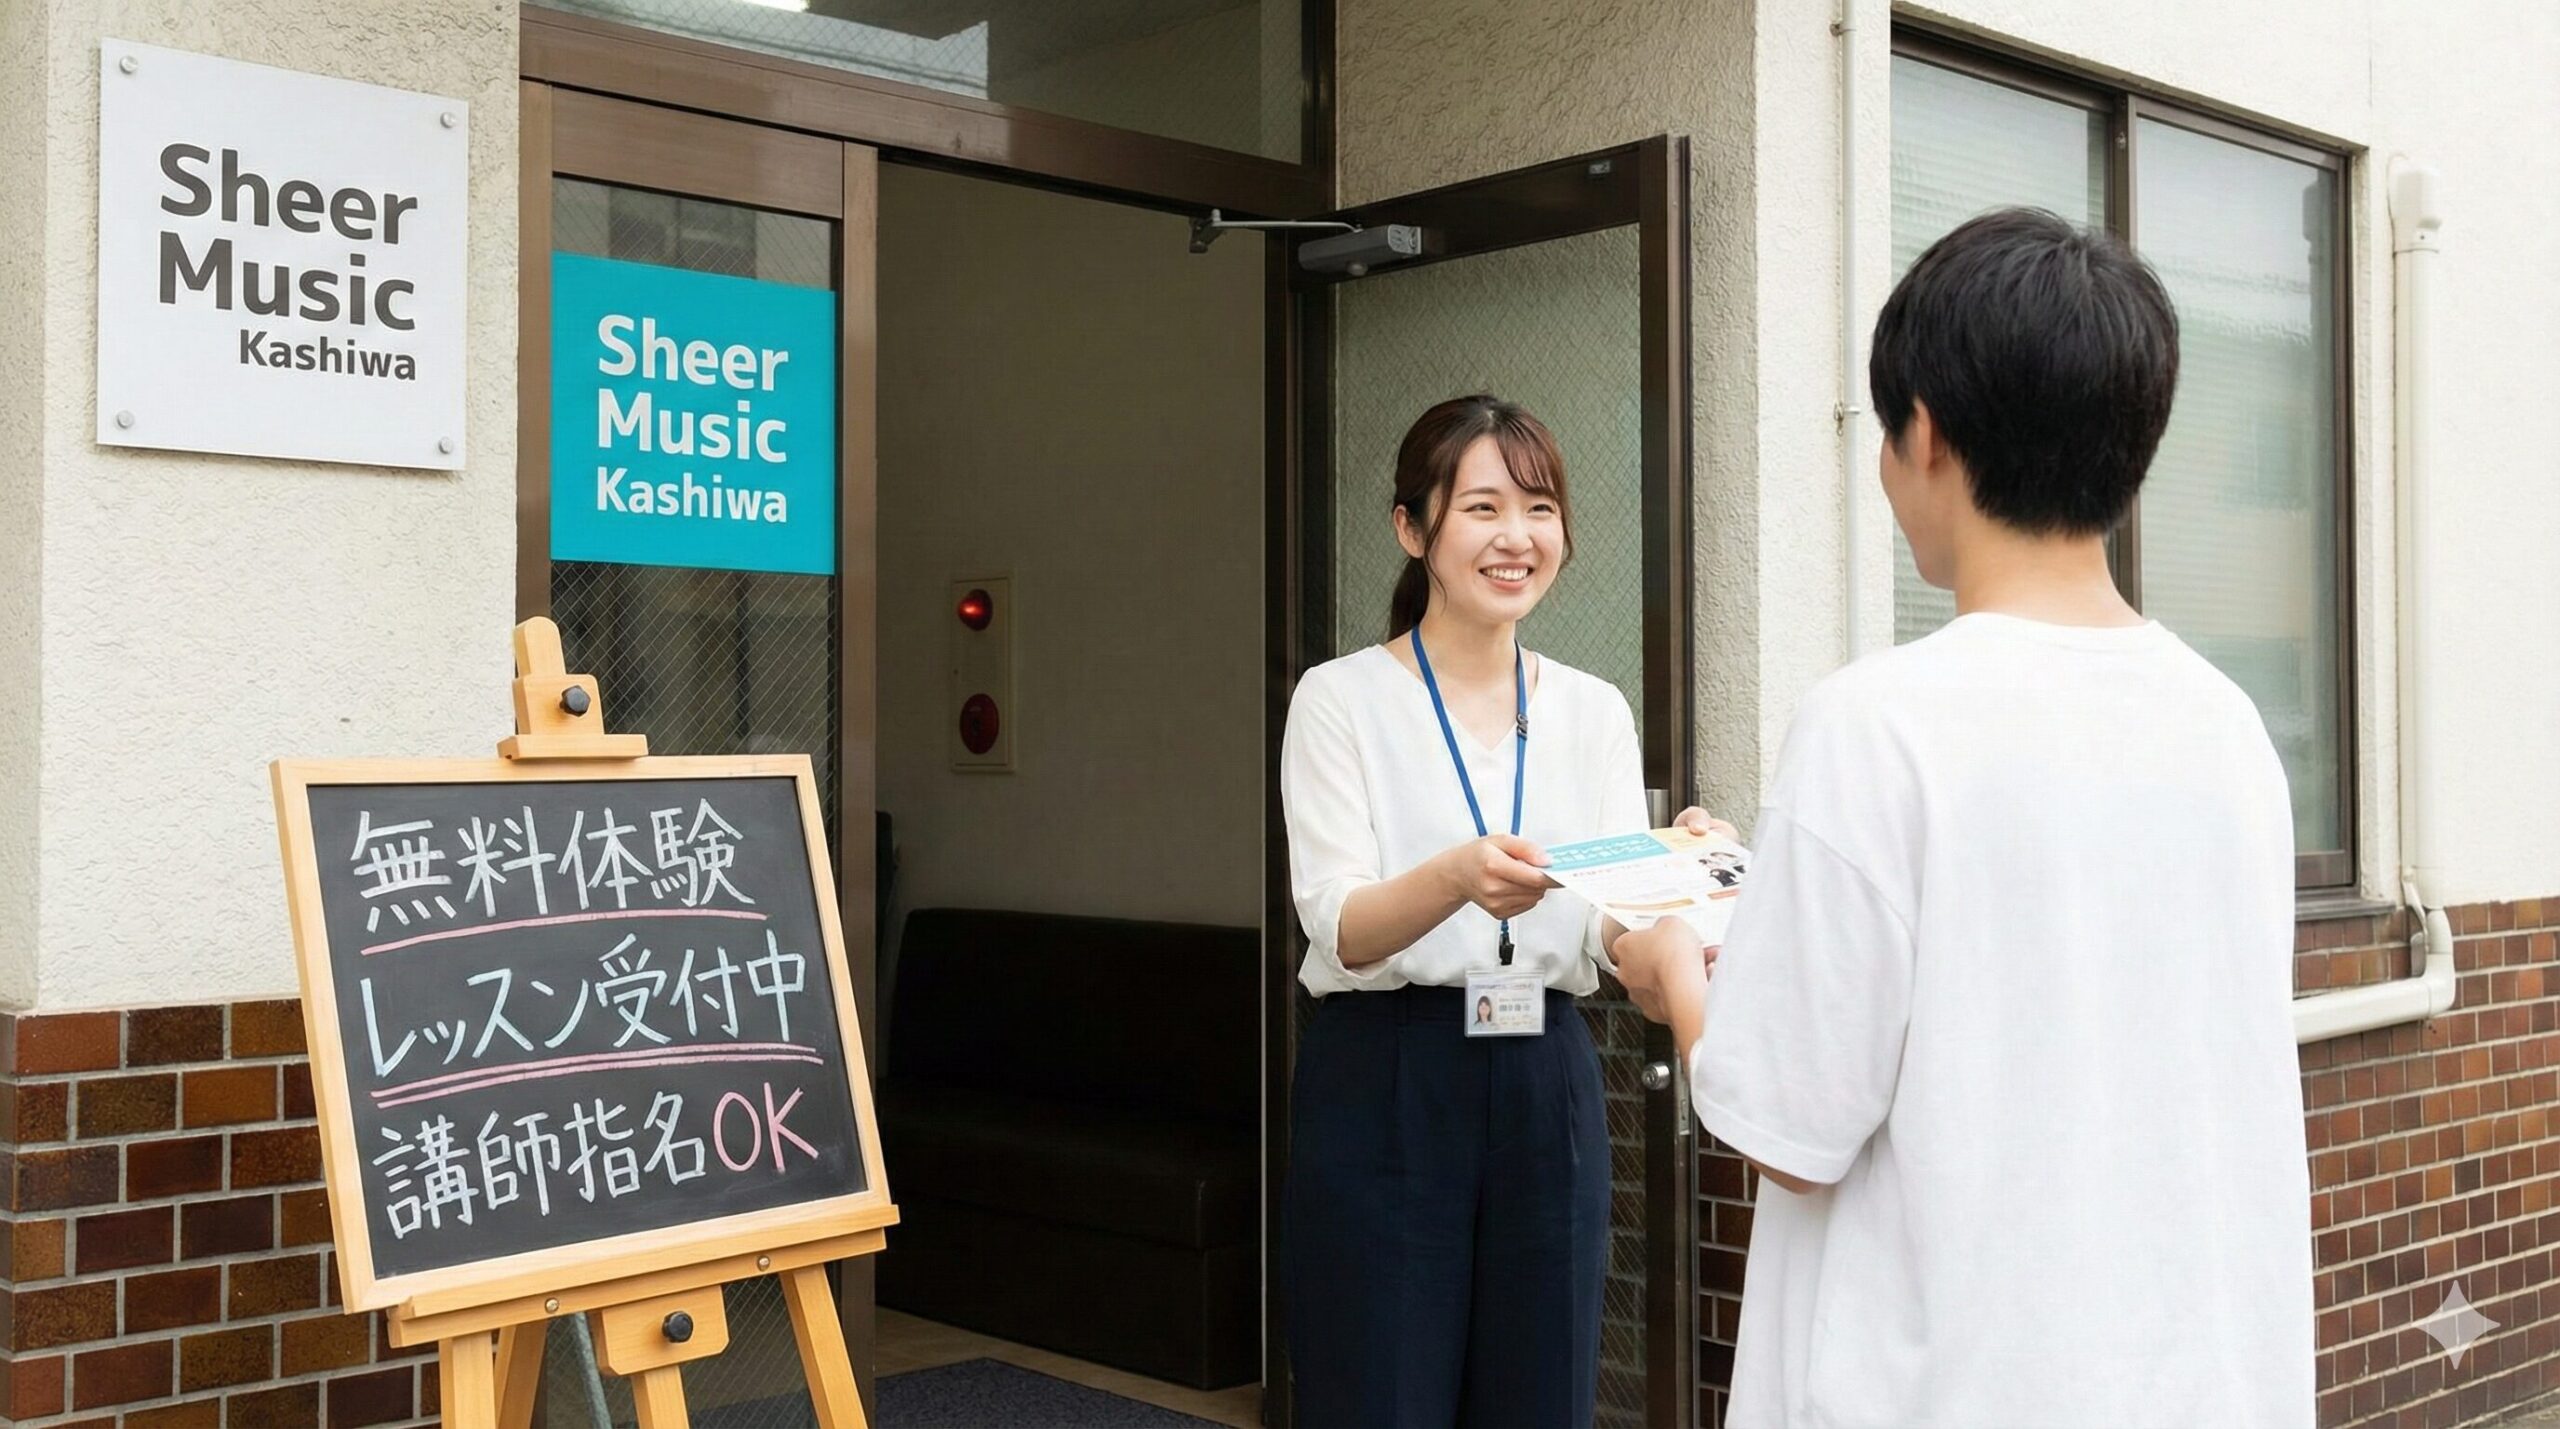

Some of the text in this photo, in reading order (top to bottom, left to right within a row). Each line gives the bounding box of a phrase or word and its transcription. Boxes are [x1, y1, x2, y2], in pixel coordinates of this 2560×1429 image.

[158, 143, 417, 245] Sheer
[158, 231, 416, 332] Music
[239, 330, 417, 382] Kashiwa
[597, 315, 789, 391] Sheer
[597, 389, 788, 464] Music
[596, 466, 789, 524] Kashiwa
[350, 798, 756, 933] 無料体験
[360, 929, 806, 1078] レッスン受付中
